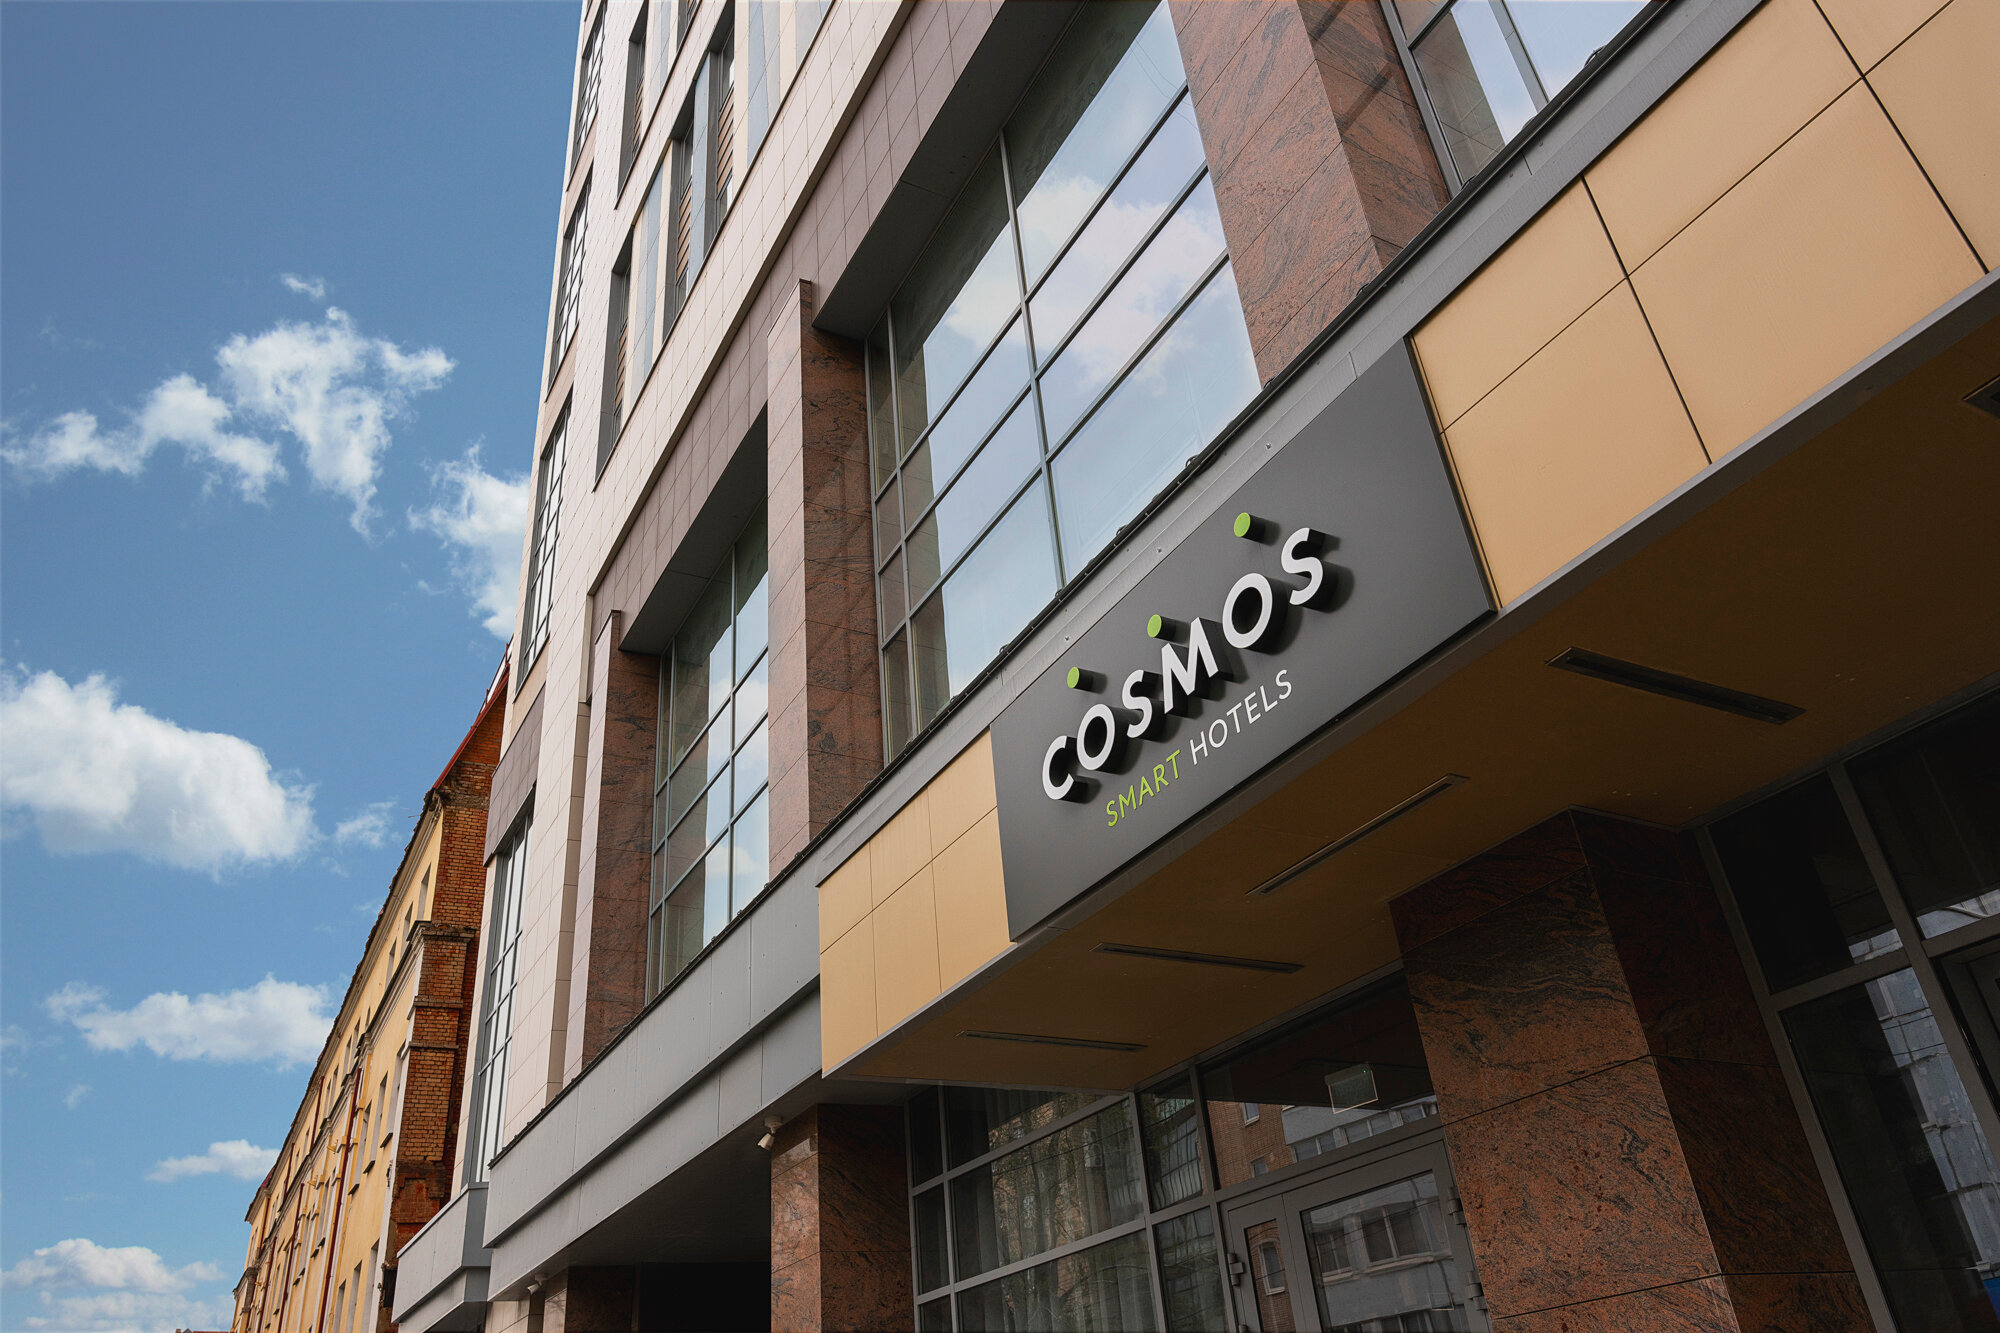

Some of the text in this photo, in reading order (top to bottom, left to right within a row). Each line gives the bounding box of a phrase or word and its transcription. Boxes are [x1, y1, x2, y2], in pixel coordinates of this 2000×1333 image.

[1042, 525, 1325, 800] COSMOS
[1106, 669, 1293, 827] SMART HOTELS
